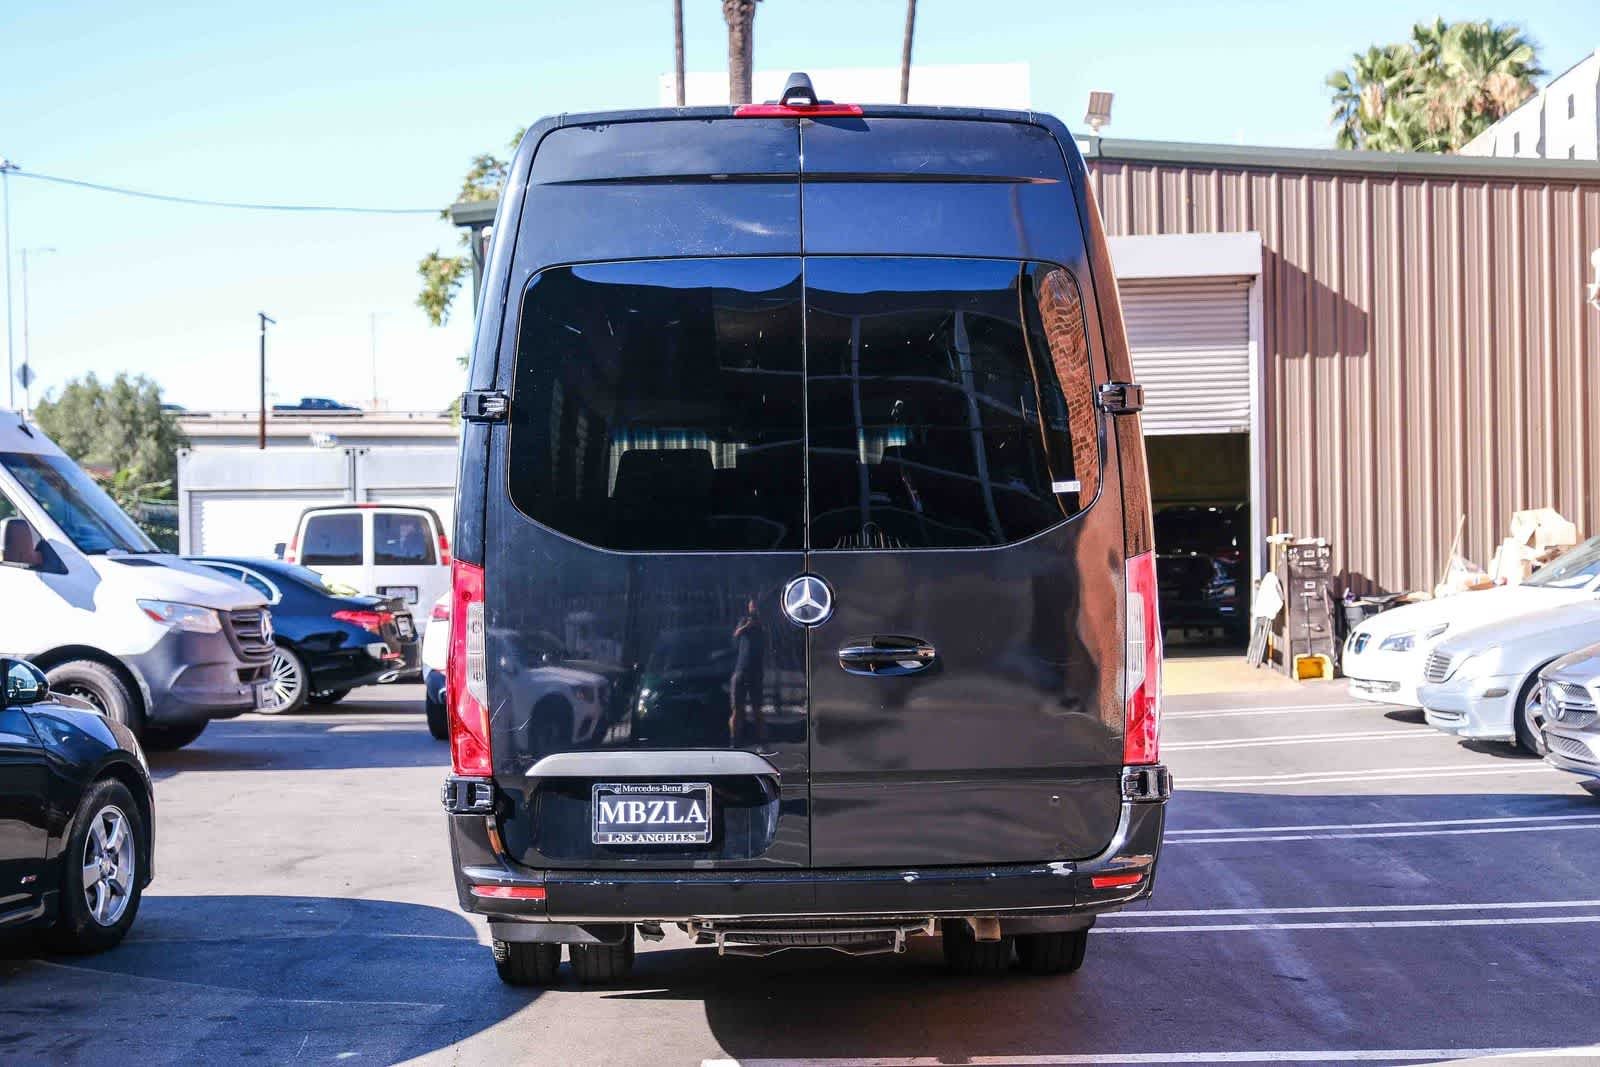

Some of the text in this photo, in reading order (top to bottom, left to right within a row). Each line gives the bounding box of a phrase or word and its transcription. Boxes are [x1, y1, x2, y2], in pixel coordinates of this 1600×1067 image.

[622, 784, 682, 793] Mercedes-Benz
[599, 800, 706, 824] MBZLA
[608, 833, 697, 842] LOS ANGELES
